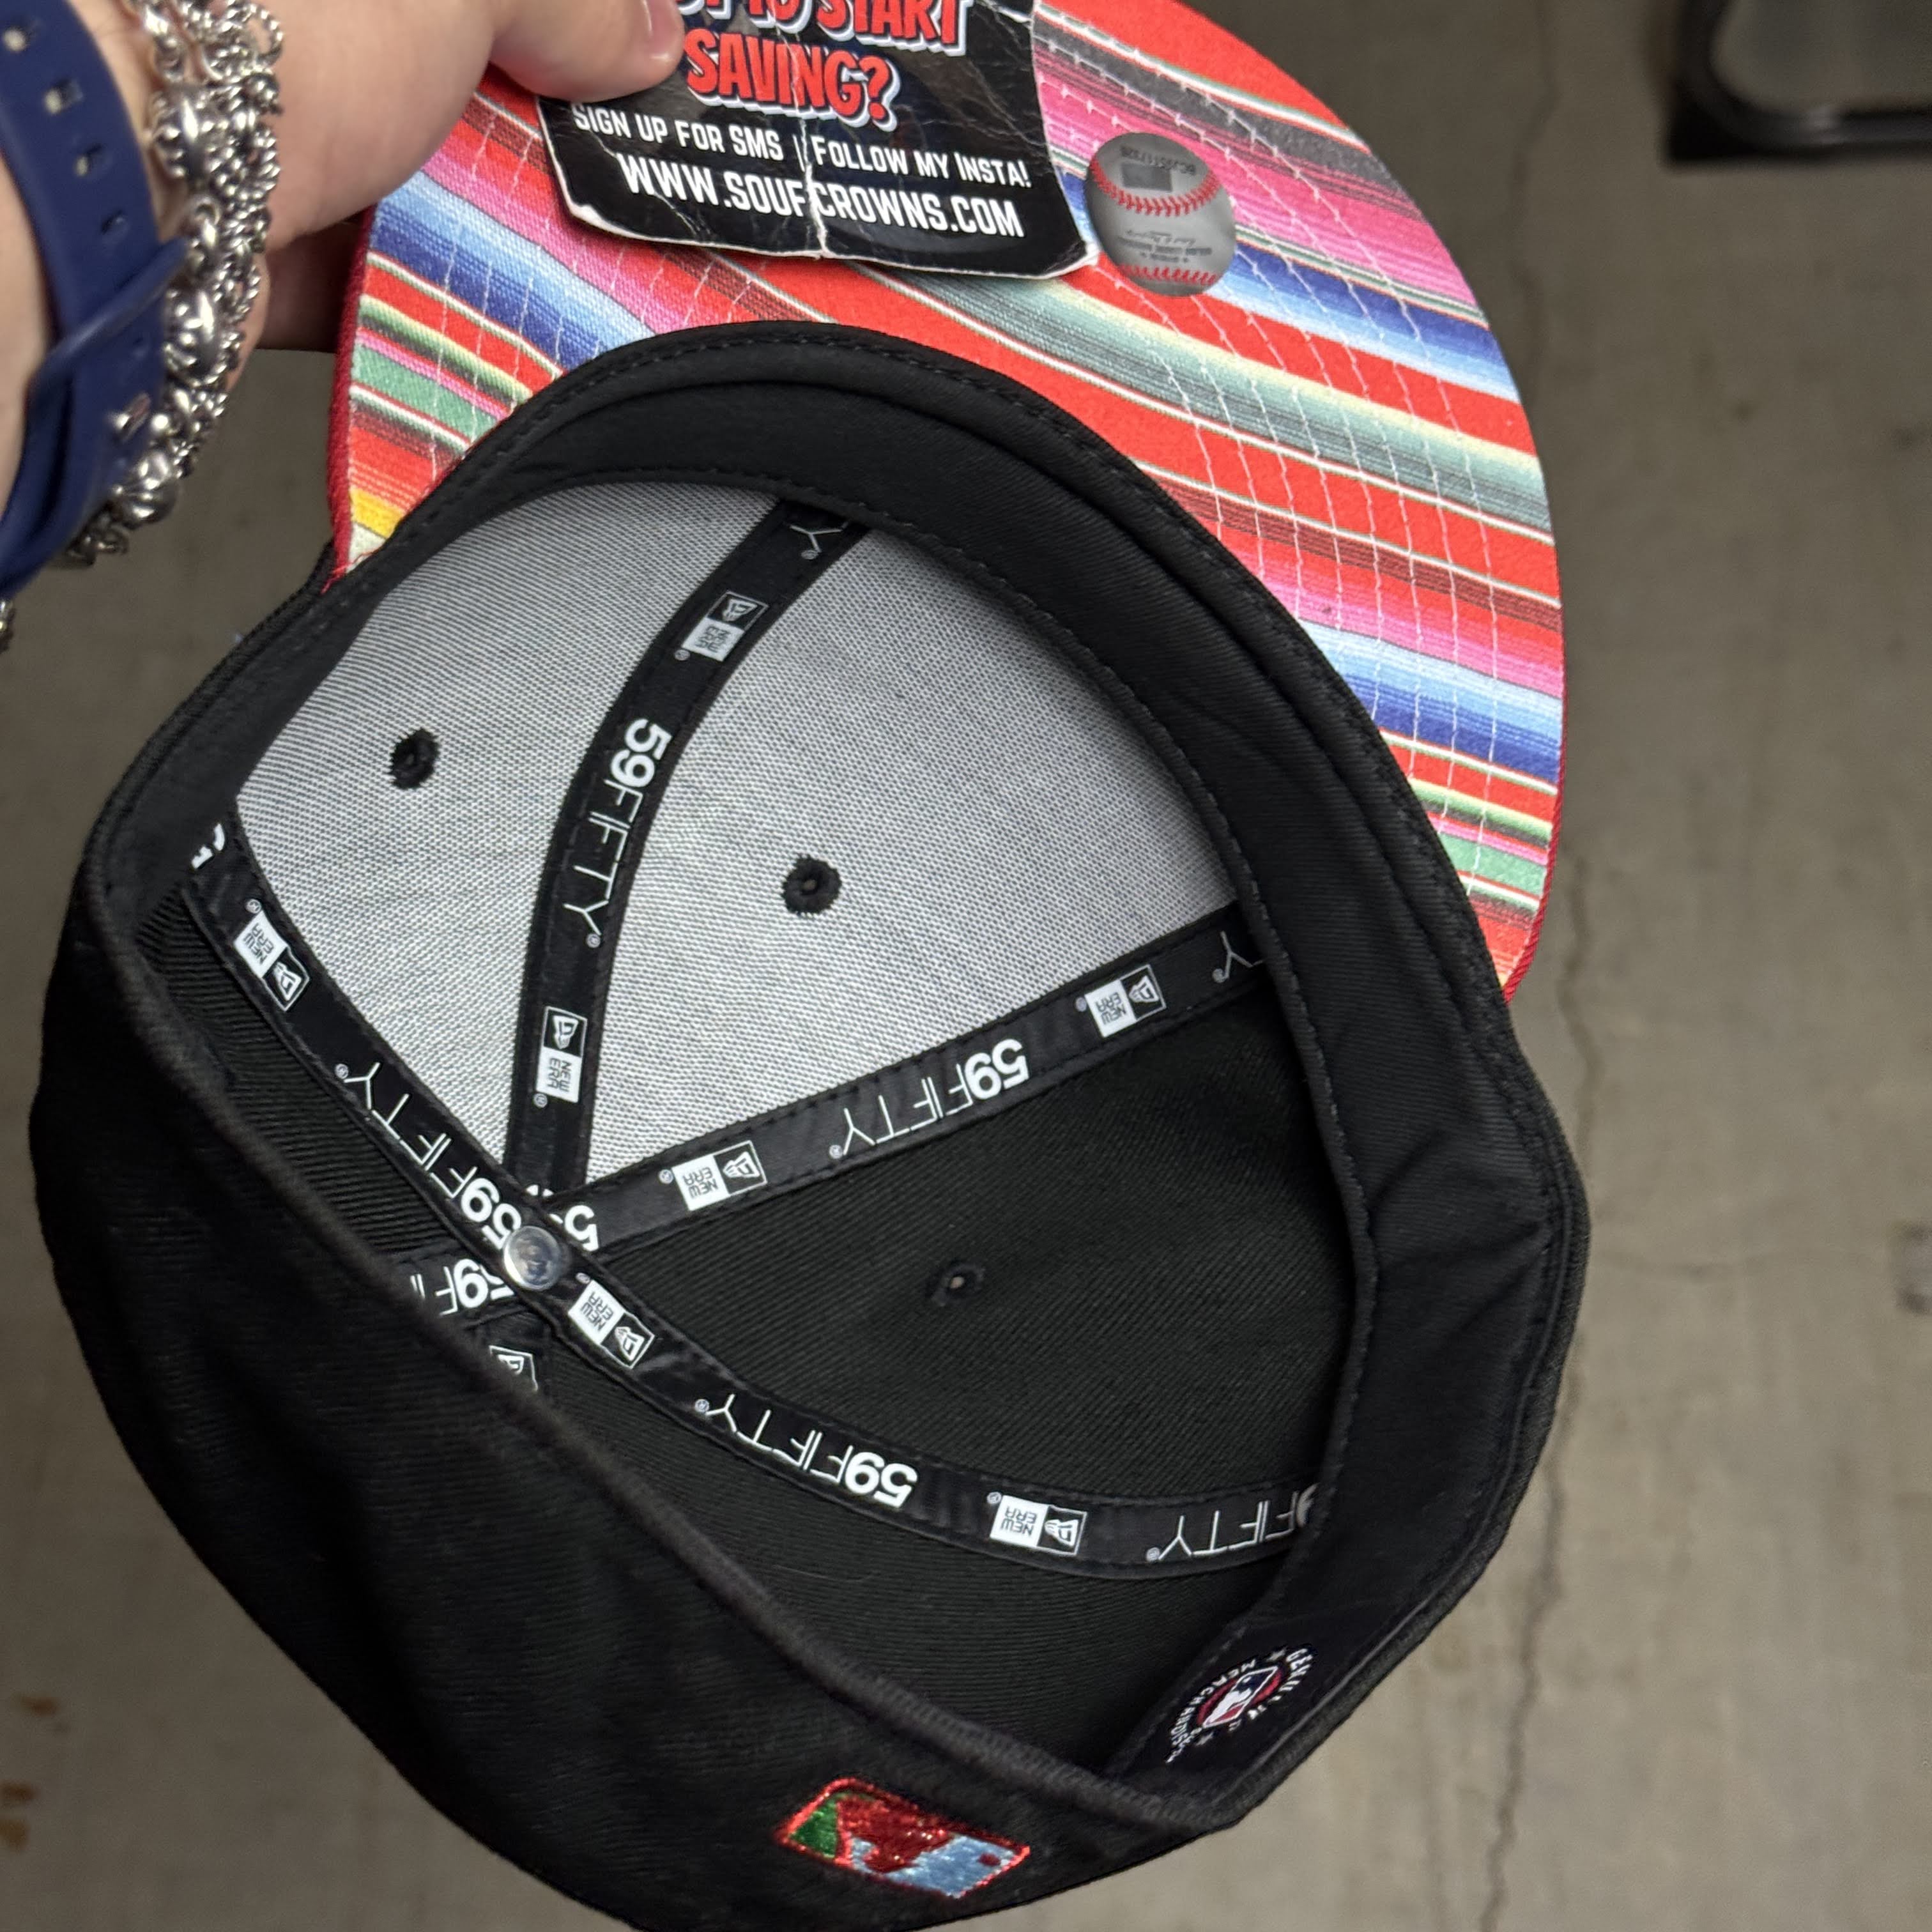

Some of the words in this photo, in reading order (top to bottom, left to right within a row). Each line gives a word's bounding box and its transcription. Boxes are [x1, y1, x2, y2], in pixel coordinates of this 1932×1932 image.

[684, 28, 896, 126] SAVING?
[572, 103, 631, 139] SIGN
[635, 113, 668, 144] UP
[674, 119, 726, 153] FOR
[729, 124, 785, 161] SMS
[811, 135, 908, 175] FOLLOW
[913, 150, 951, 180] MY
[954, 151, 1032, 188] INSTA!
[616, 153, 1025, 238] WWW.SOUFCROWNS.COM
[564, 718, 672, 935] 59FIFTY
[547, 1057, 561, 1089] ERA
[558, 1060, 572, 1093] NEW
[843, 1038, 1030, 1155] 59FIFTY
[344, 1062, 521, 1250] 59FIFTY
[682, 1166, 714, 1186] ERA
[688, 1178, 719, 1199] NEW
[579, 1301, 607, 1332] NEW
[588, 1291, 614, 1321] ERA
[706, 1393, 918, 1508] 59FIFTY
[1000, 1517, 1034, 1537] NEW
[1004, 1506, 1038, 1524] ERA
